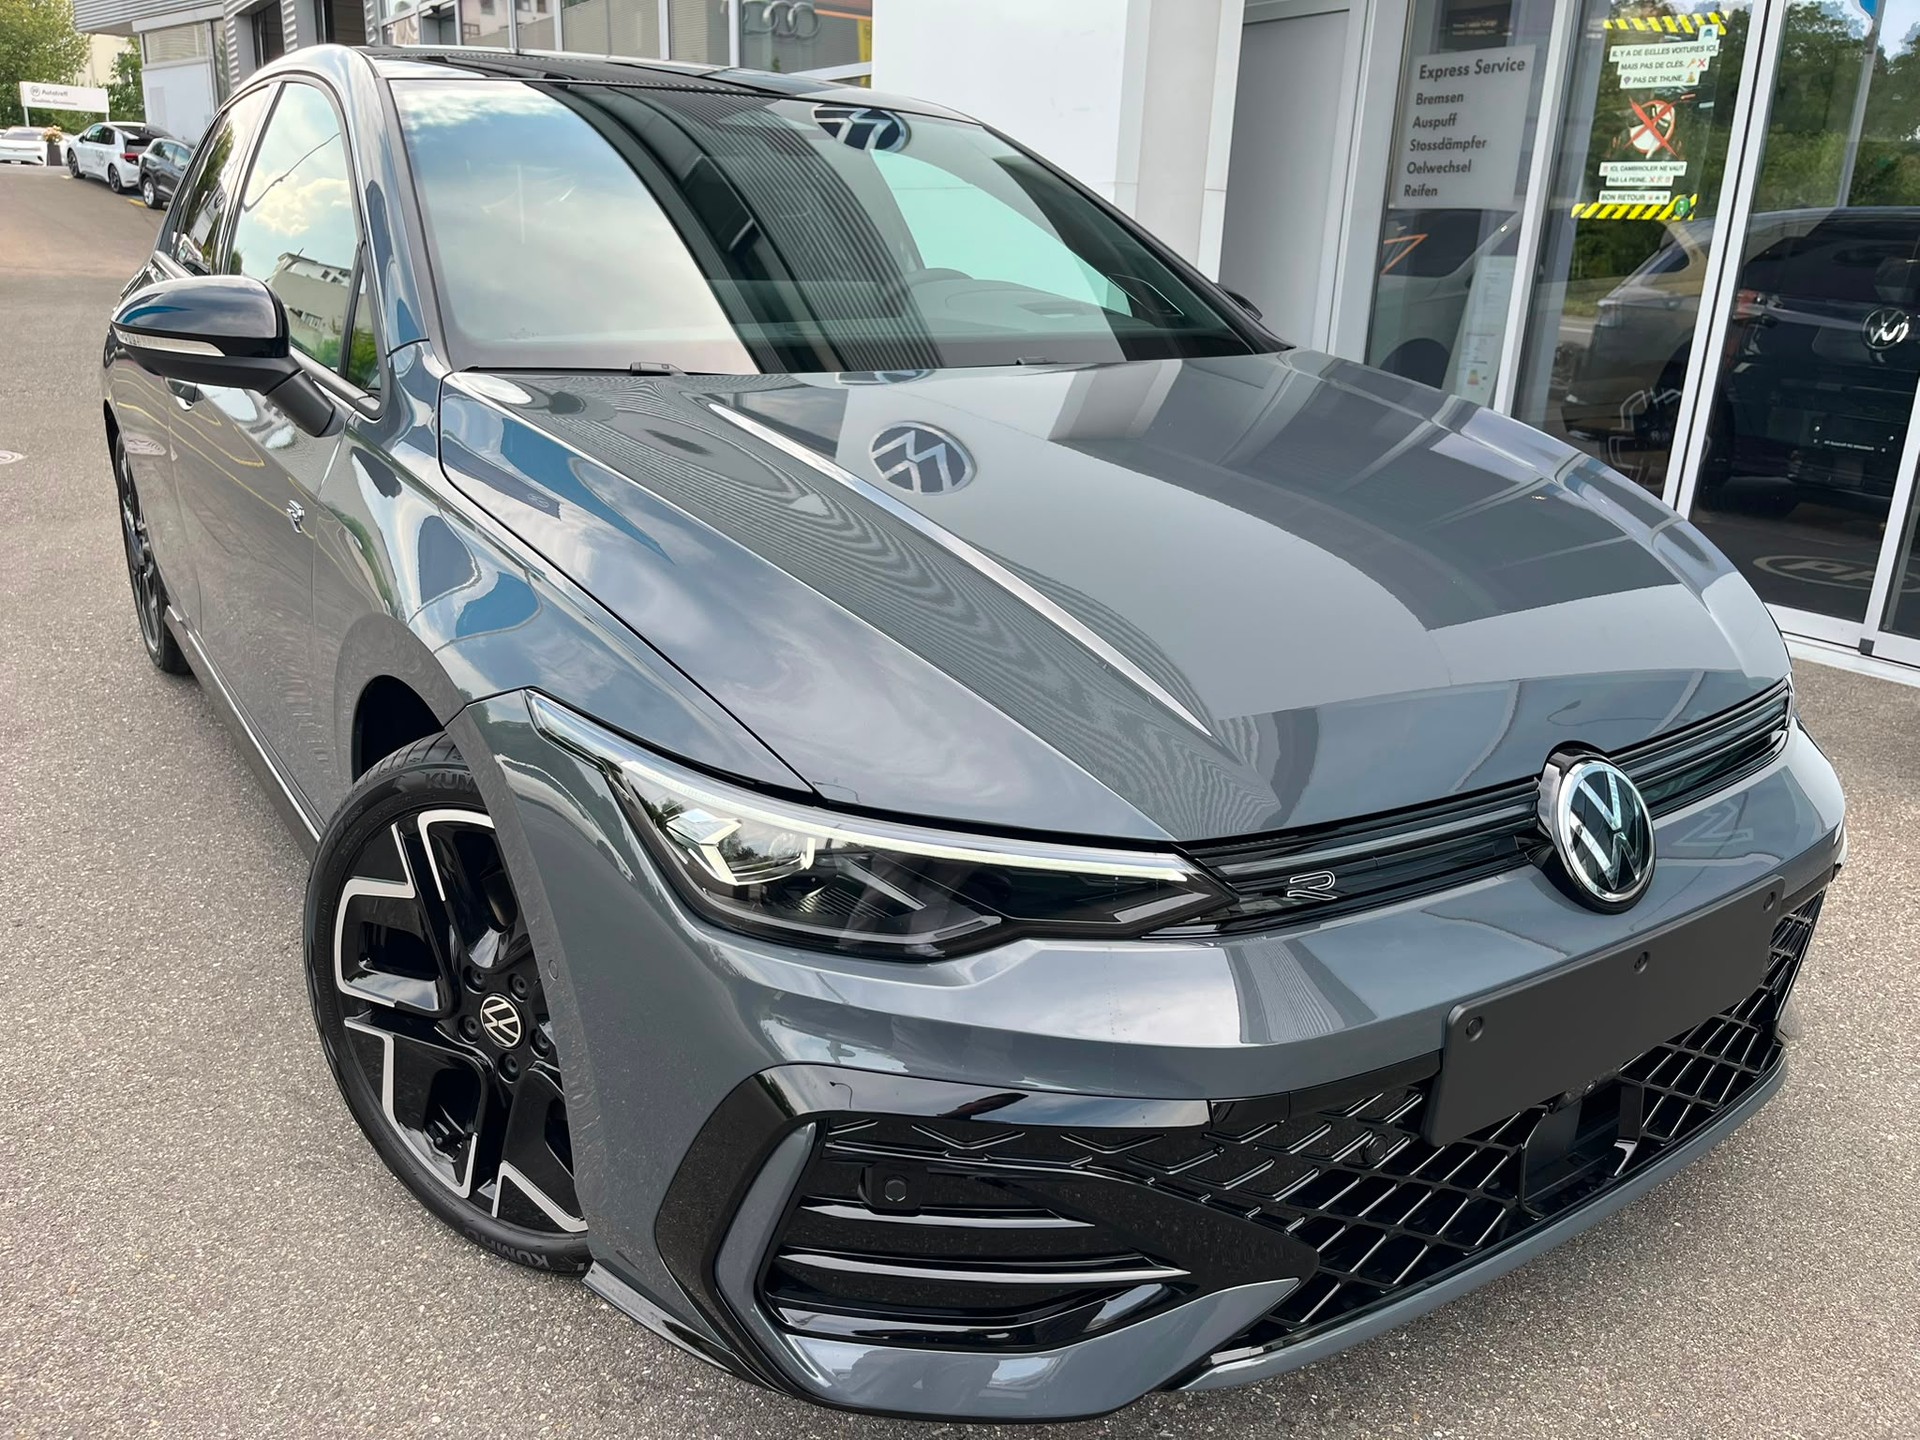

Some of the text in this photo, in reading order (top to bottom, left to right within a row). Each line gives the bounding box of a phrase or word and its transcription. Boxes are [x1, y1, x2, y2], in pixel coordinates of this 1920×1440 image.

[1644, 47, 1670, 56] BELLES
[1672, 45, 1705, 55] VOITURES
[1419, 57, 1526, 82] Express Service
[1620, 62, 1639, 70] MAIS
[1639, 61, 1654, 70] PAS
[1655, 61, 1665, 69] DE
[1632, 76, 1646, 84] PAS
[1648, 75, 1658, 83] DE
[1416, 92, 1464, 105] Bremsen
[1412, 112, 1458, 130] Auspuff
[1409, 135, 1488, 152] Stossdämpfer
[1406, 159, 1472, 175] Oelwechsel
[1404, 183, 1438, 197] Reifen
[425, 772, 481, 795] KUM
